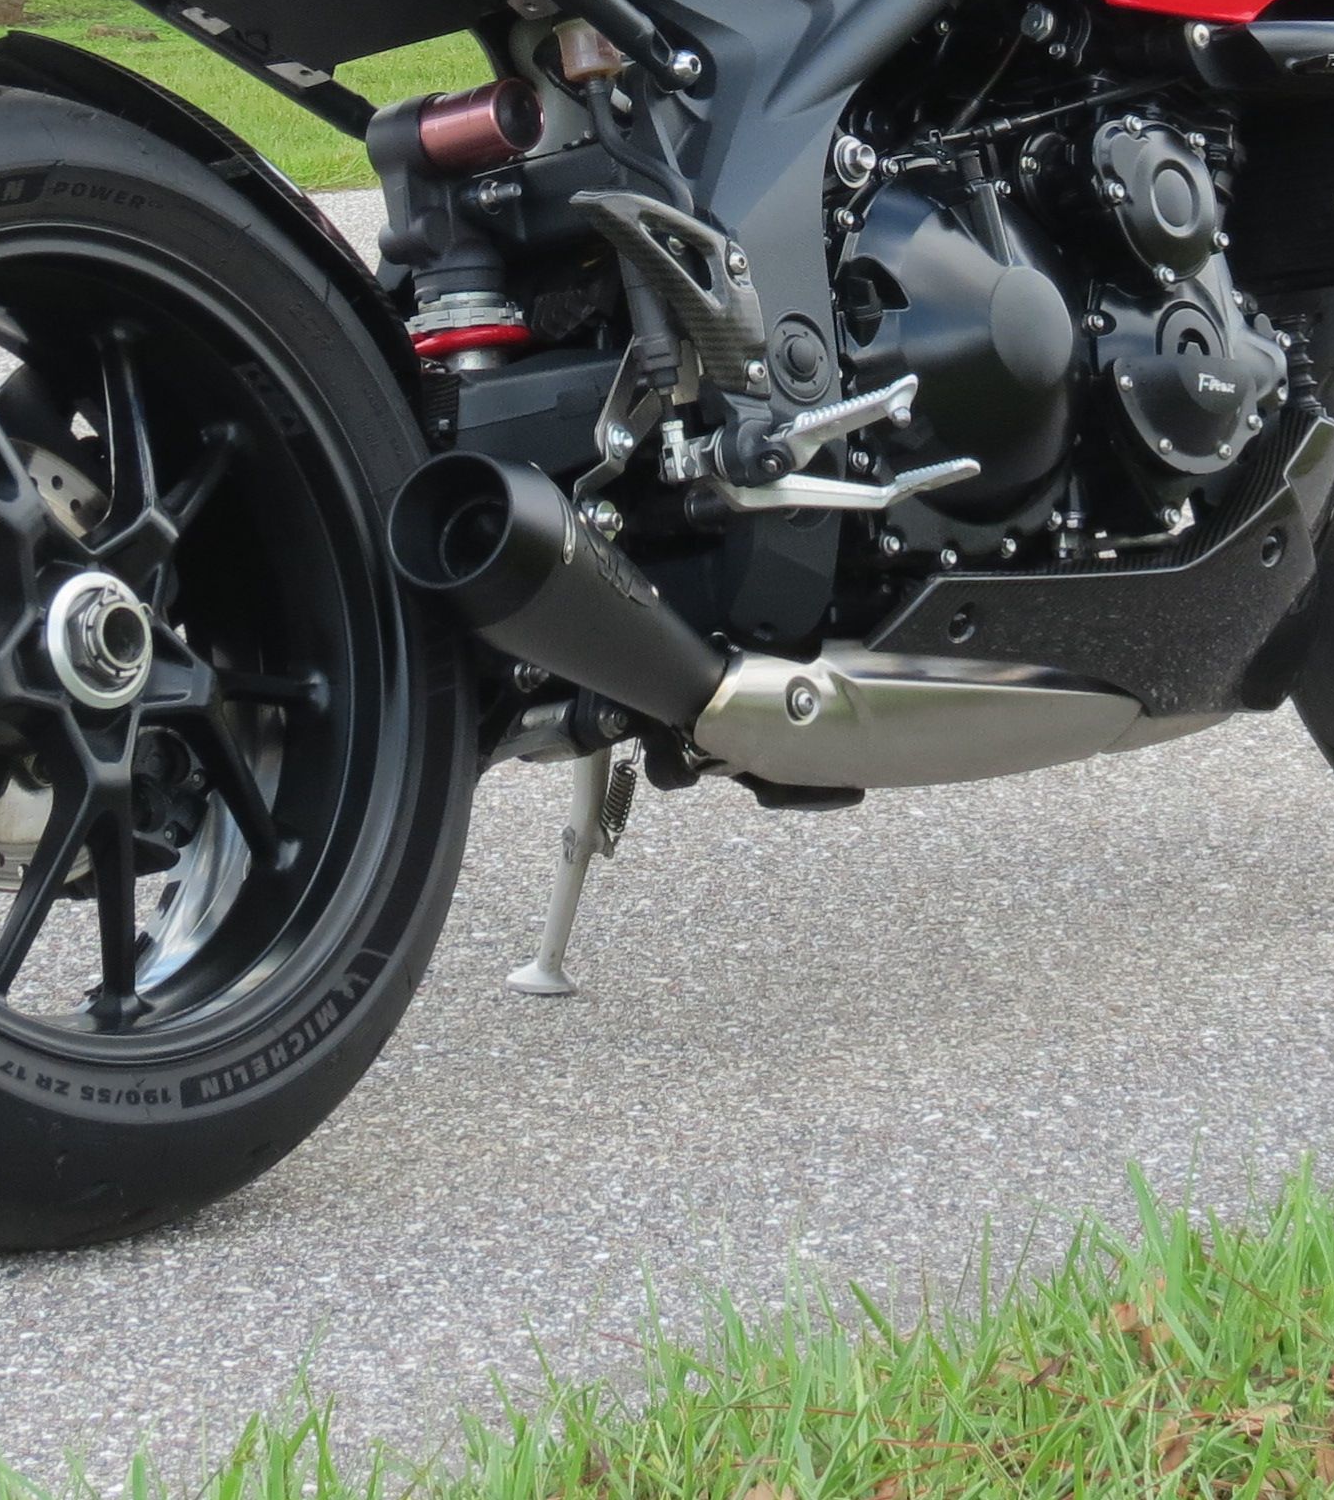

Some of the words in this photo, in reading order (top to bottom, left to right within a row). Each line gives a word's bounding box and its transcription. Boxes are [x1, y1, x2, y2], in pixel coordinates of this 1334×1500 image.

[49, 181, 146, 210] POWER
[199, 999, 340, 1099] MICHELIN
[35, 1073, 71, 1096] ZR
[80, 1085, 173, 1105] 190/55
